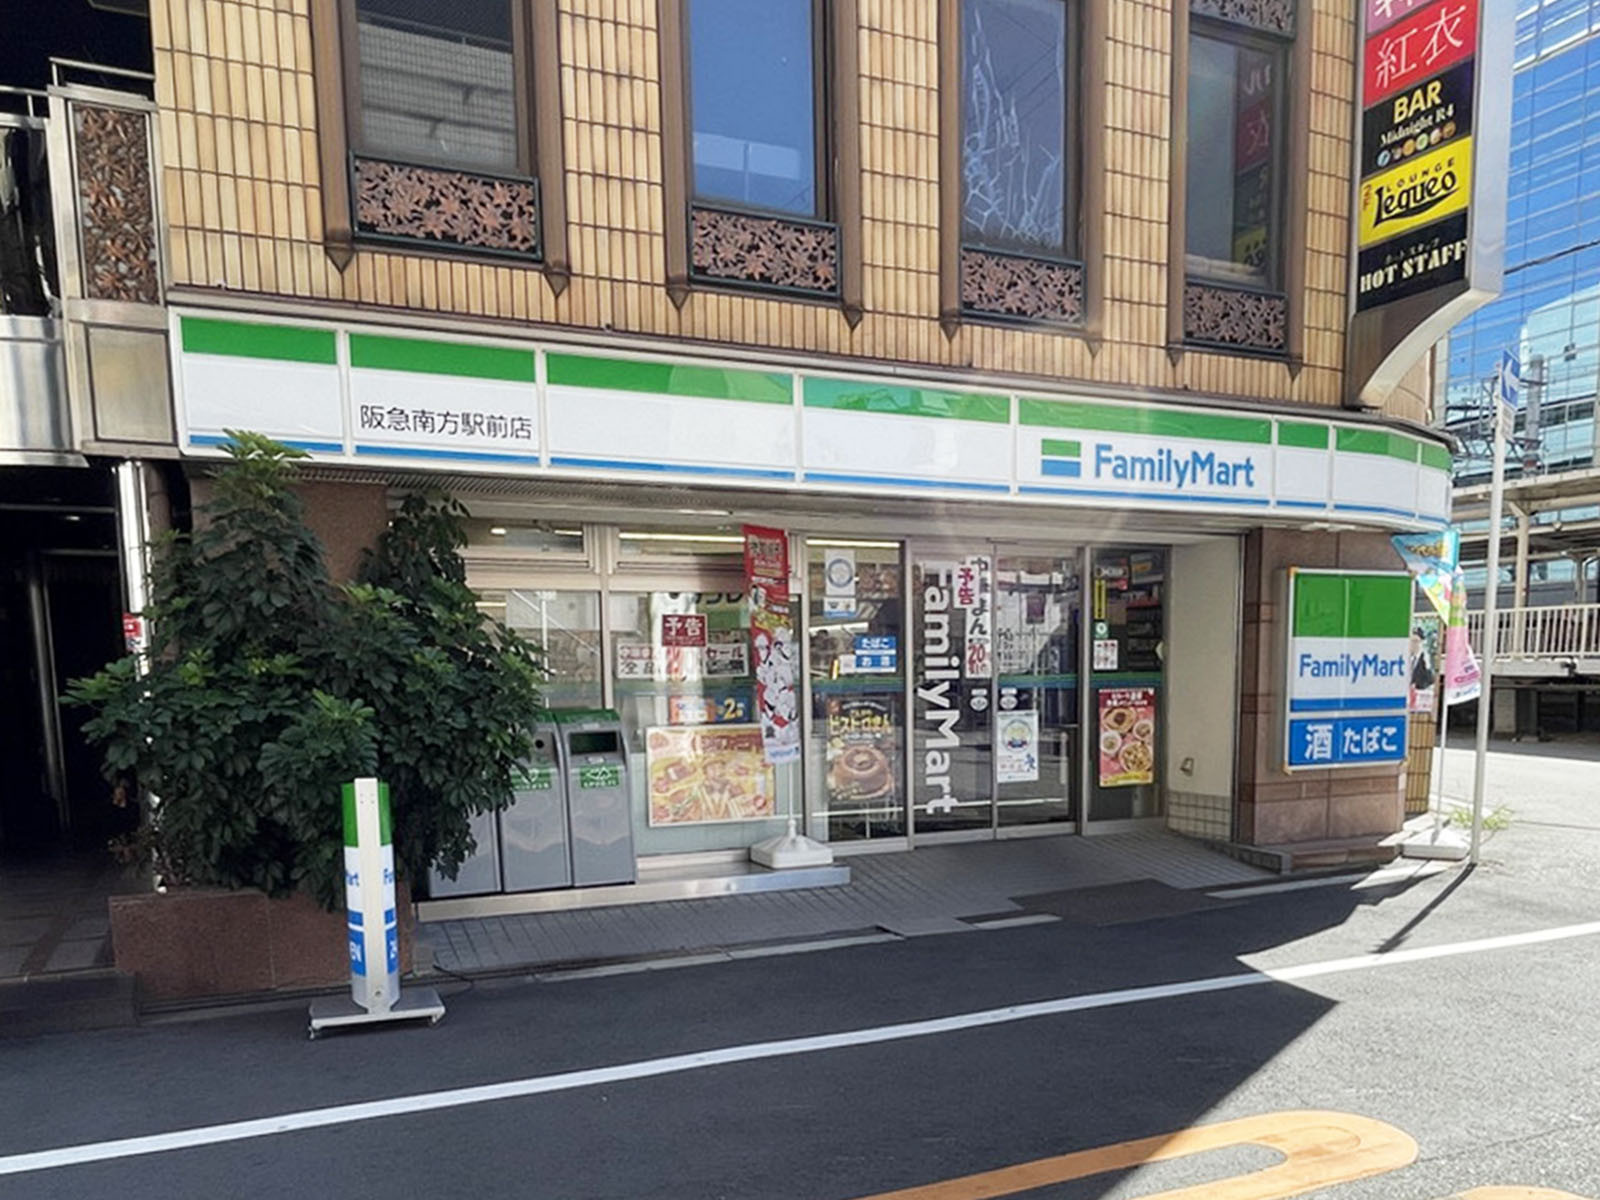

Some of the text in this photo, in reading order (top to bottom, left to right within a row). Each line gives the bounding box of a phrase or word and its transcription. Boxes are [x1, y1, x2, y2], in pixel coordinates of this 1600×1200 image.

[1375, 6, 1467, 88] 紅衣
[1393, 79, 1442, 124] BAR
[1379, 114, 1434, 148] Midnight
[1385, 156, 1455, 193] LOUNGE
[1360, 239, 1467, 293] HOT STAFF
[360, 404, 532, 440] 阪急南方駅前店
[1095, 443, 1255, 489] FamilyMart
[664, 616, 703, 636] 予告
[1299, 653, 1405, 683] FamilyMart
[1304, 723, 1397, 760] 酒 たばこ
